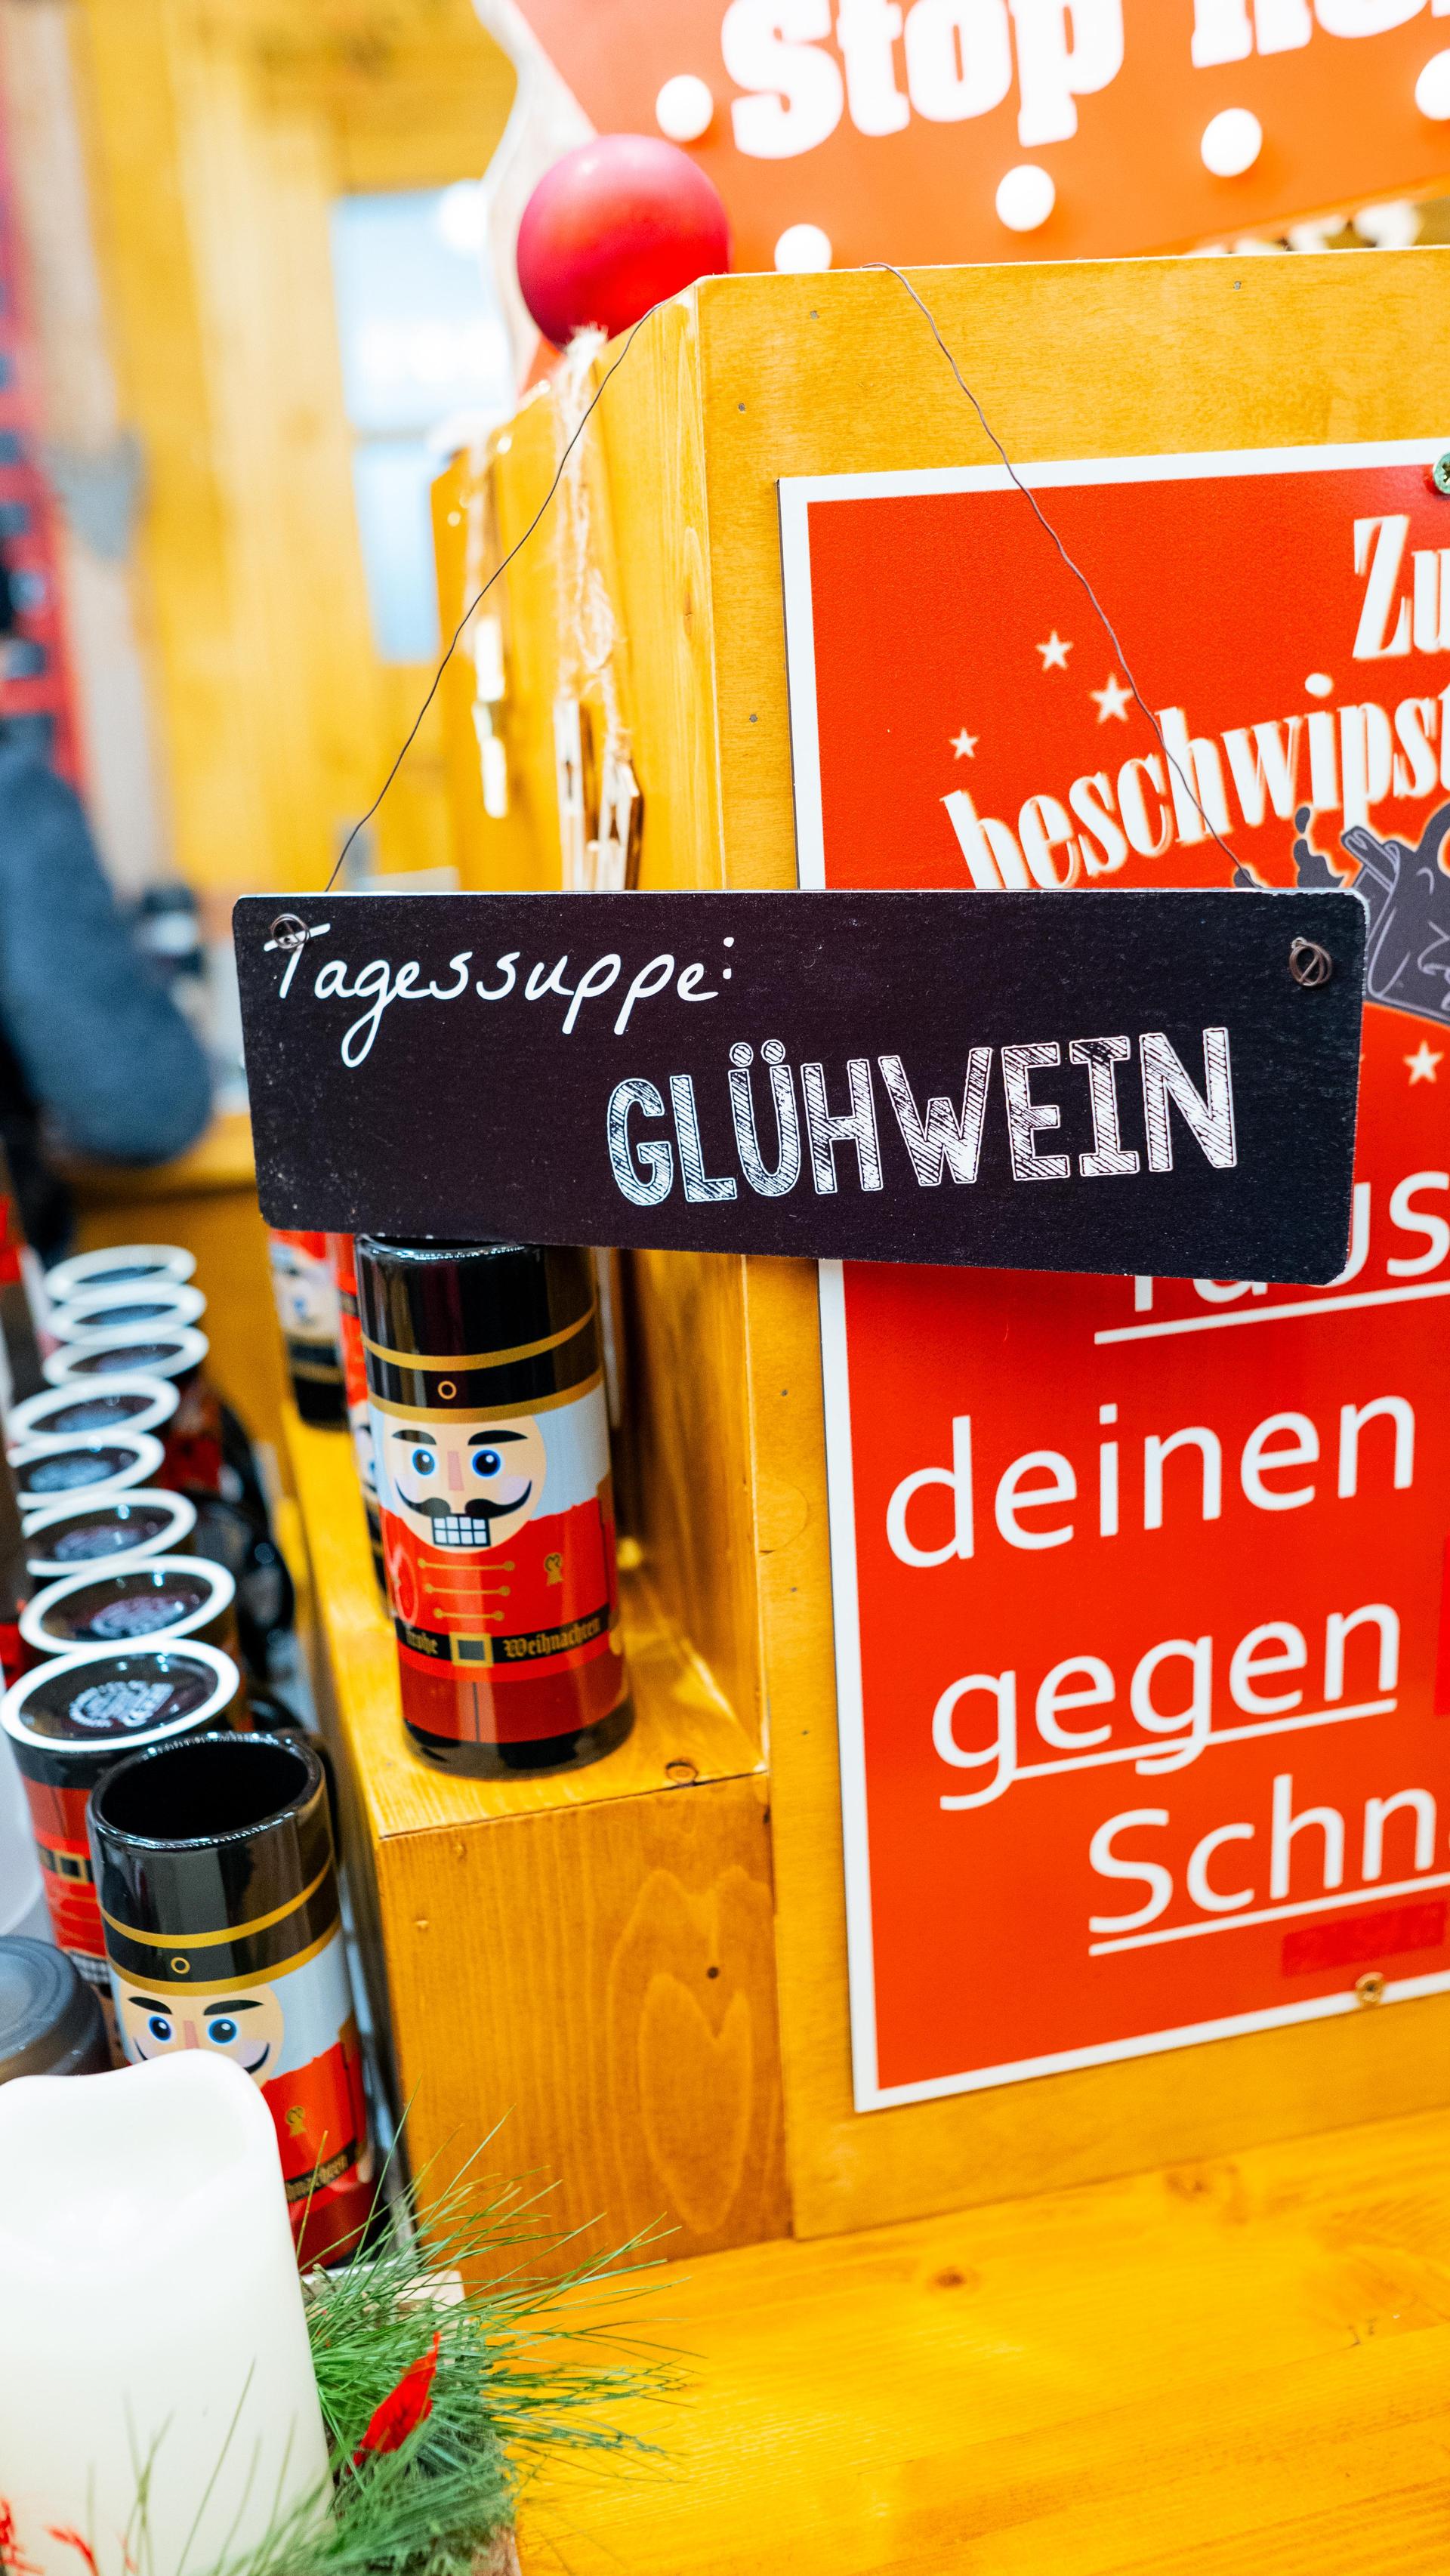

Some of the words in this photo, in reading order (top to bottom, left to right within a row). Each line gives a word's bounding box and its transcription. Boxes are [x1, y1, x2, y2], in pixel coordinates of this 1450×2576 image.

[721, 0, 1125, 159] Stop
[263, 922, 734, 1068] Tagessuppe:
[607, 1027, 1237, 1206] GLÜHWEIN
[886, 1395, 1416, 1569] deinen
[501, 1616, 602, 1658] Weihnachten
[931, 1603, 1401, 1811] gegen
[1088, 1773, 1450, 1934] Schn
